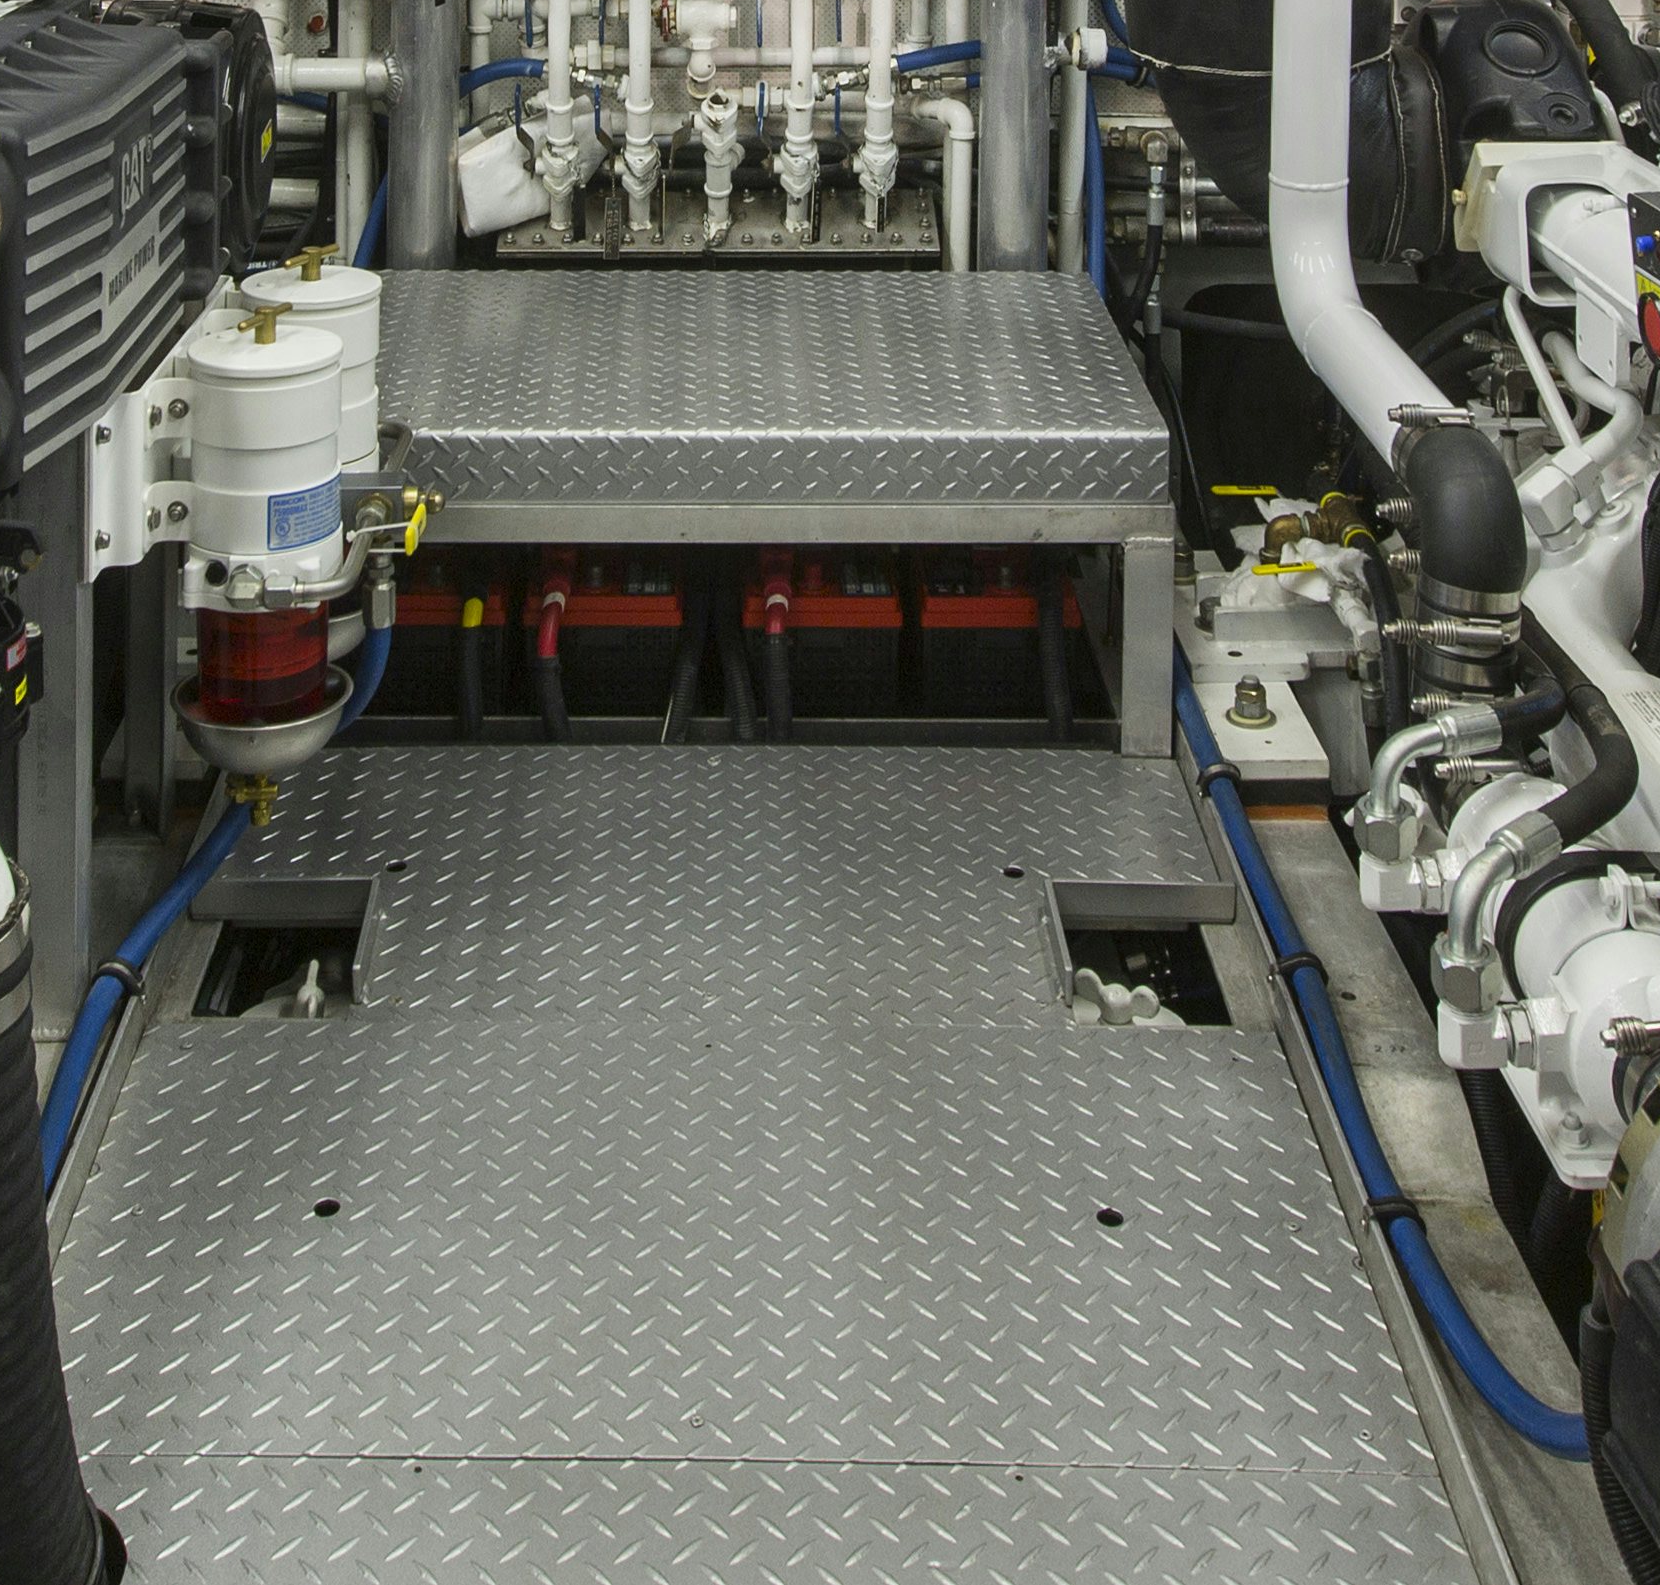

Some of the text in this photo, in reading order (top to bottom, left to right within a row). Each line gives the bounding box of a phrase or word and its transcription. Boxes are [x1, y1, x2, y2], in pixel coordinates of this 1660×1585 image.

[121, 135, 147, 215] CAT
[108, 235, 156, 306] MARINE POWER
